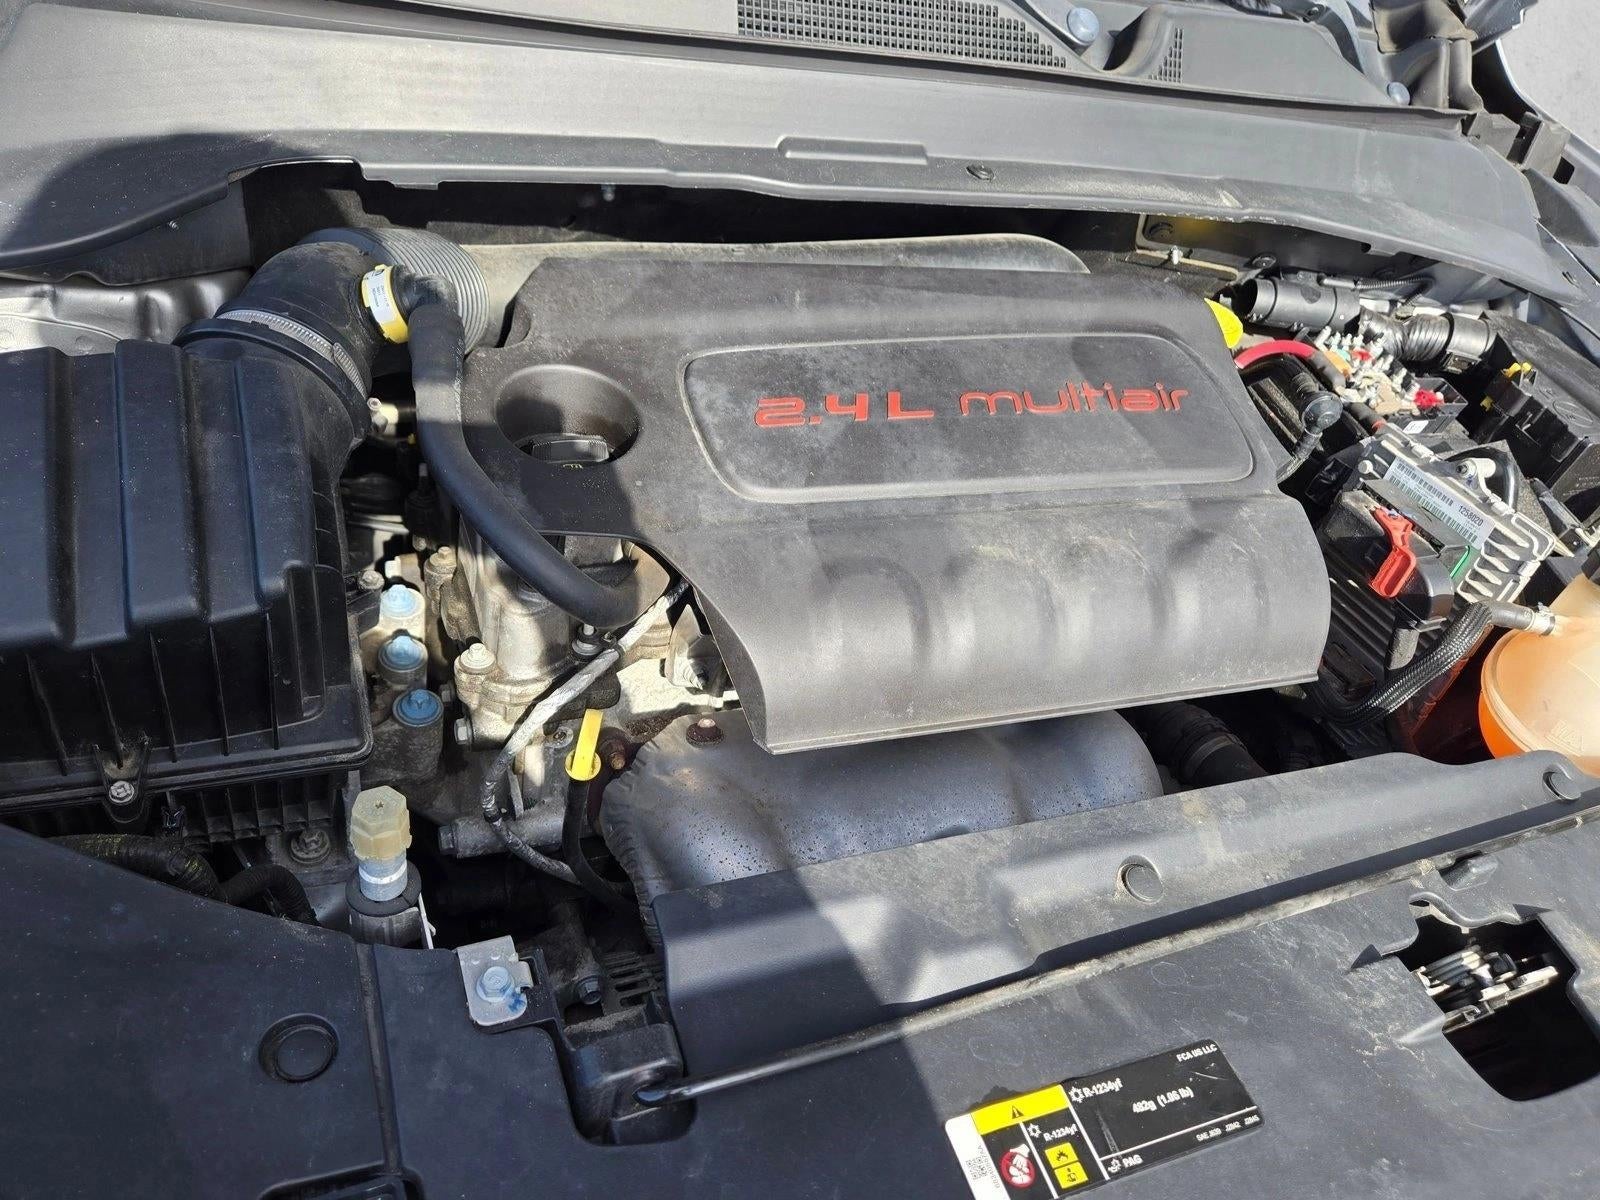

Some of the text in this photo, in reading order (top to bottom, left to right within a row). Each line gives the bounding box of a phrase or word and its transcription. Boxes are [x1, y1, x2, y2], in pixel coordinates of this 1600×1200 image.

[959, 379, 1190, 417] multiair
[1458, 505, 1484, 527] 1258020
[1176, 1044, 1218, 1063] FCA US LLC
[1083, 1078, 1124, 1098] R-1234yf
[1132, 1098, 1158, 1113] 482g
[1178, 1086, 1195, 1099] lb)
[1043, 1123, 1079, 1142] R-1234yf
[1122, 1154, 1144, 1168] PAG
